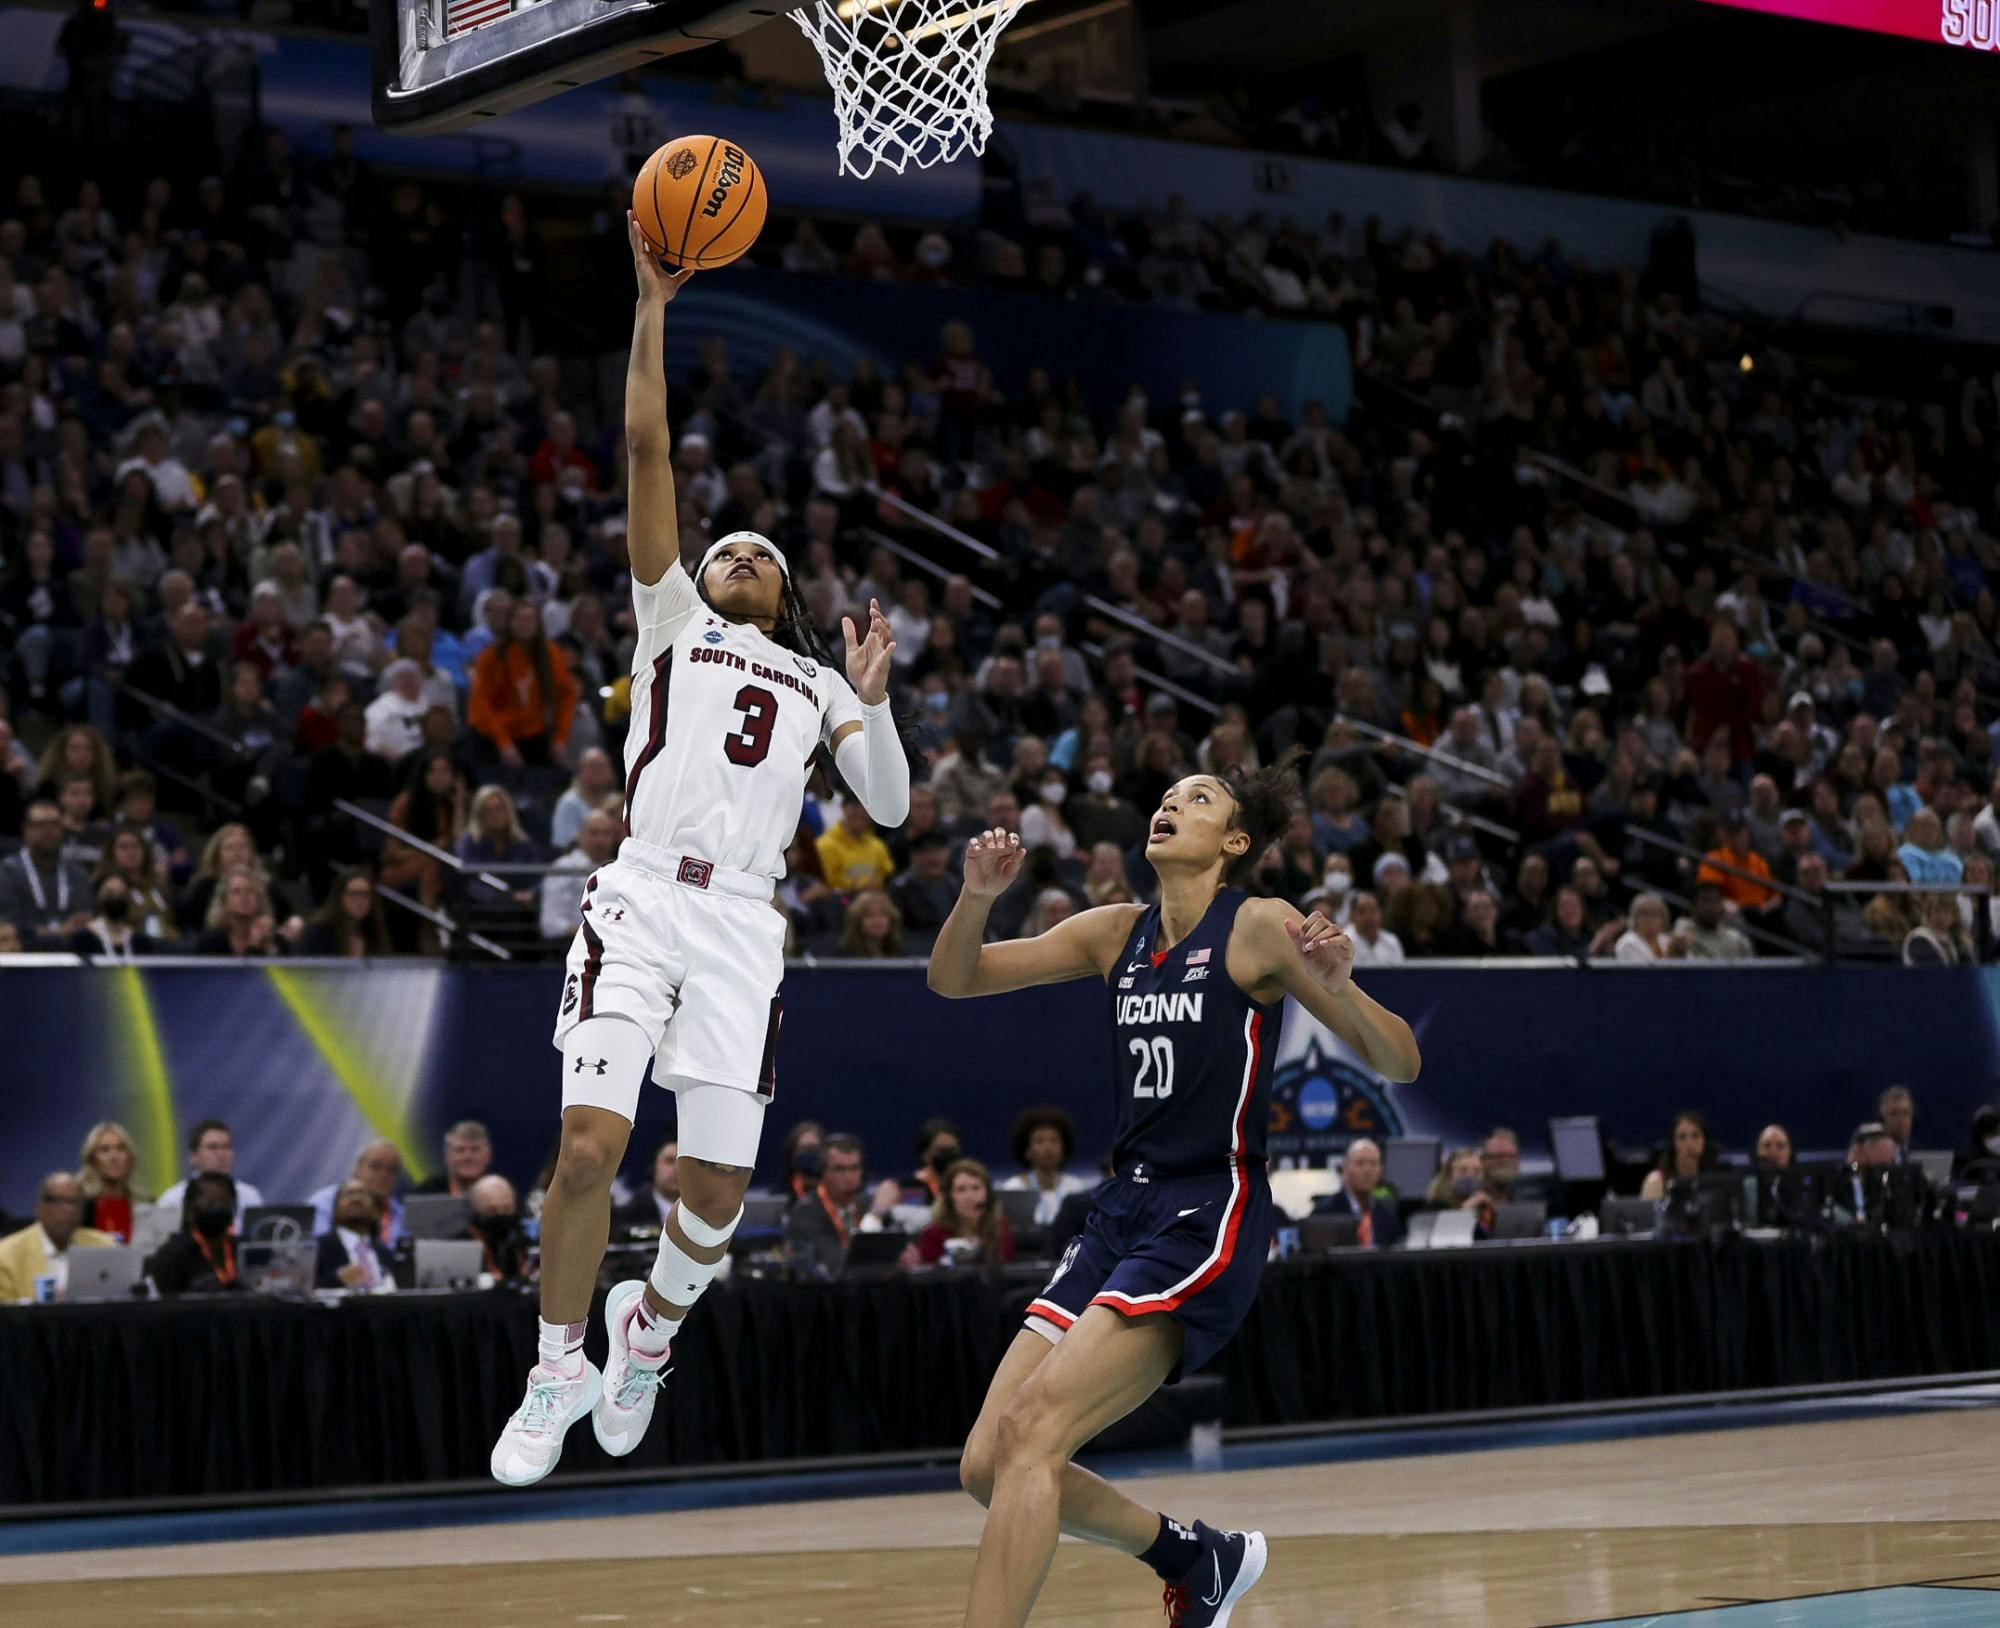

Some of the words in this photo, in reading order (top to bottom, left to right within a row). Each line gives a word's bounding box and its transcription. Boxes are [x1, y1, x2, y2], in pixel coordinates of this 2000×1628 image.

[1941, 0, 2000, 51] SO
[702, 145, 745, 218] Wilson
[689, 647, 746, 671] SOUTH
[751, 662, 820, 713] CAROLINA
[723, 683, 779, 768] 3
[1116, 992, 1204, 1026] UCONN
[1128, 1035, 1175, 1099] 20
